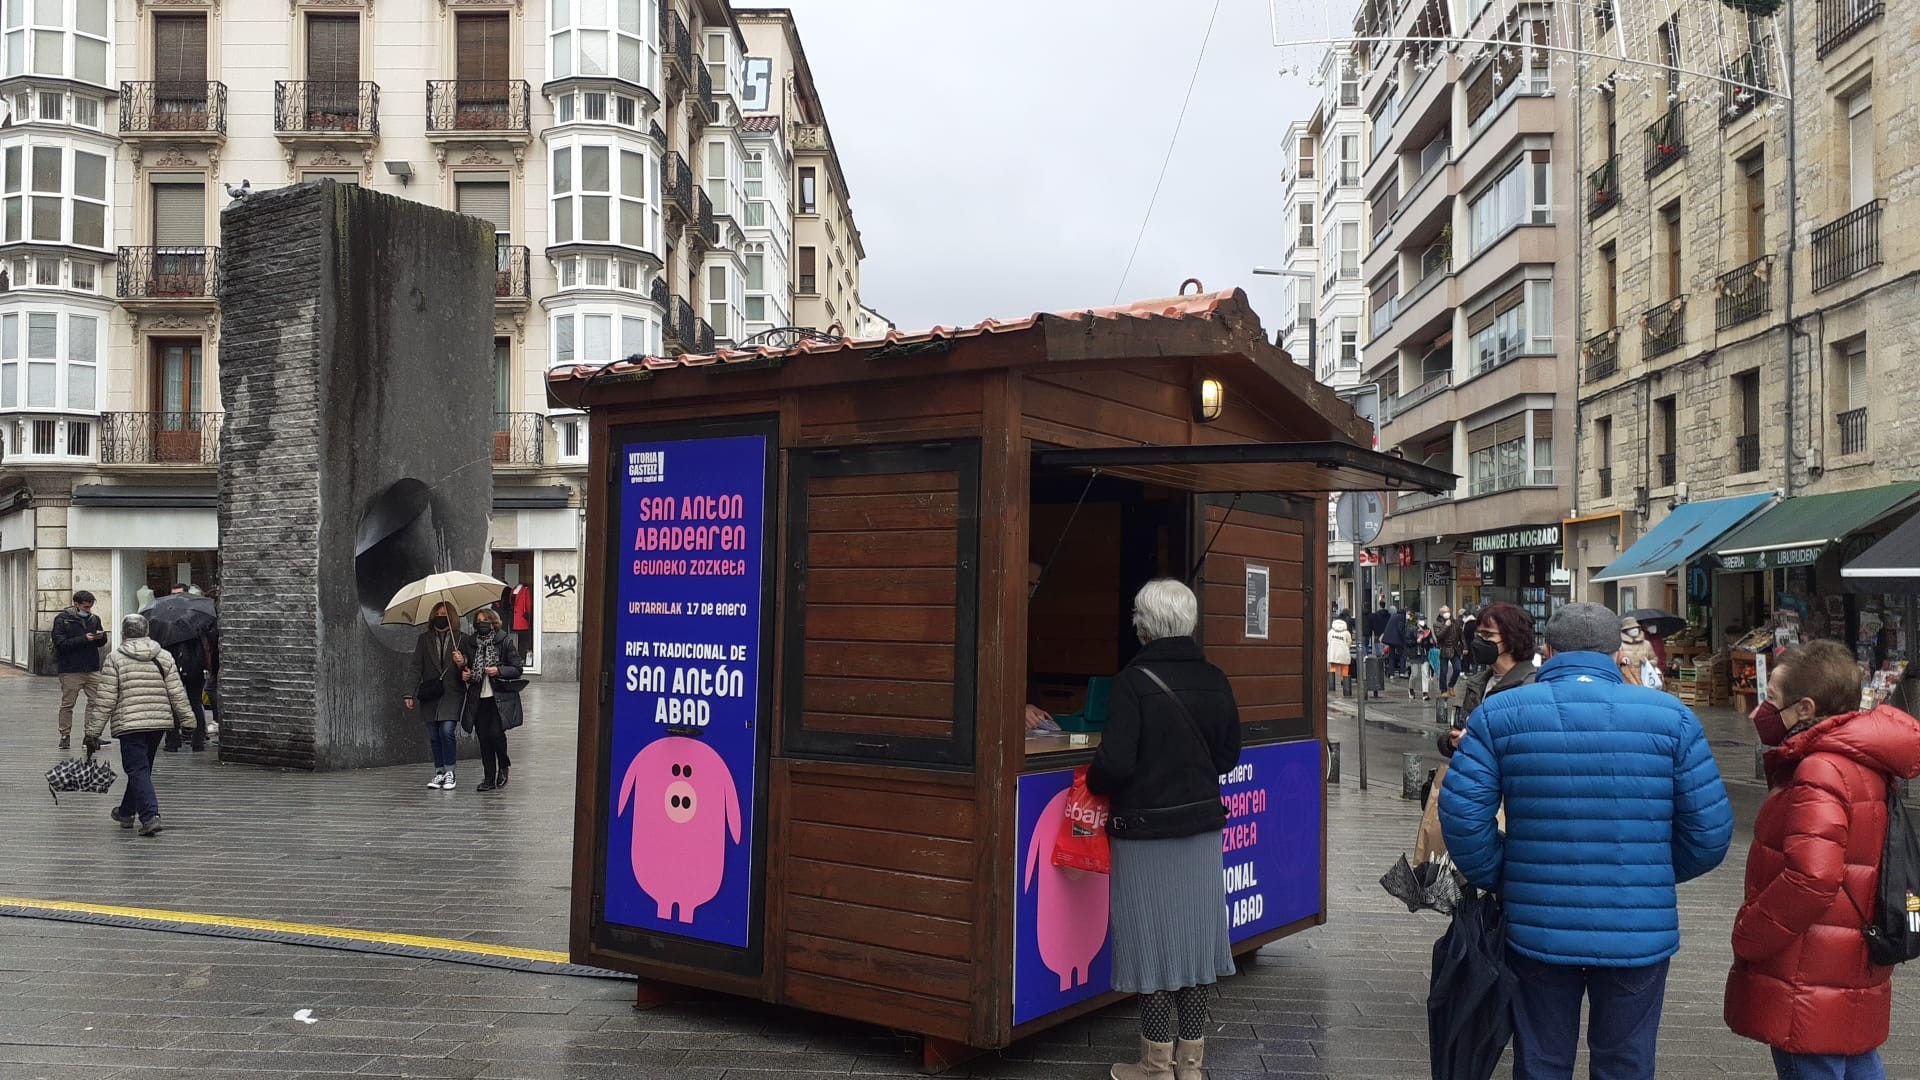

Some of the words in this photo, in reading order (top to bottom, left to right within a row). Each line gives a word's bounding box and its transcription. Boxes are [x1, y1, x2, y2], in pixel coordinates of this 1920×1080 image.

[629, 451, 657, 465] VITORIA
[629, 464, 657, 476] GASTEIZ
[1472, 533, 1508, 552] FERNANDEZ
[1509, 531, 1518, 549] DE
[1520, 526, 1558, 547] NOGRARO
[1722, 555, 1745, 568] BRERIA
[628, 601, 682, 615] URTARRILAK
[686, 602, 699, 616] 17
[625, 641, 650, 657] RIFA
[652, 642, 727, 660] TRADICIONAL
[730, 645, 746, 661] DE
[654, 697, 711, 727] ABAD
[1064, 801, 1109, 829] ebaja
[1222, 821, 1257, 852] ZKETA
[1223, 861, 1257, 895] IONAL
[1232, 893, 1263, 928] ABAD
